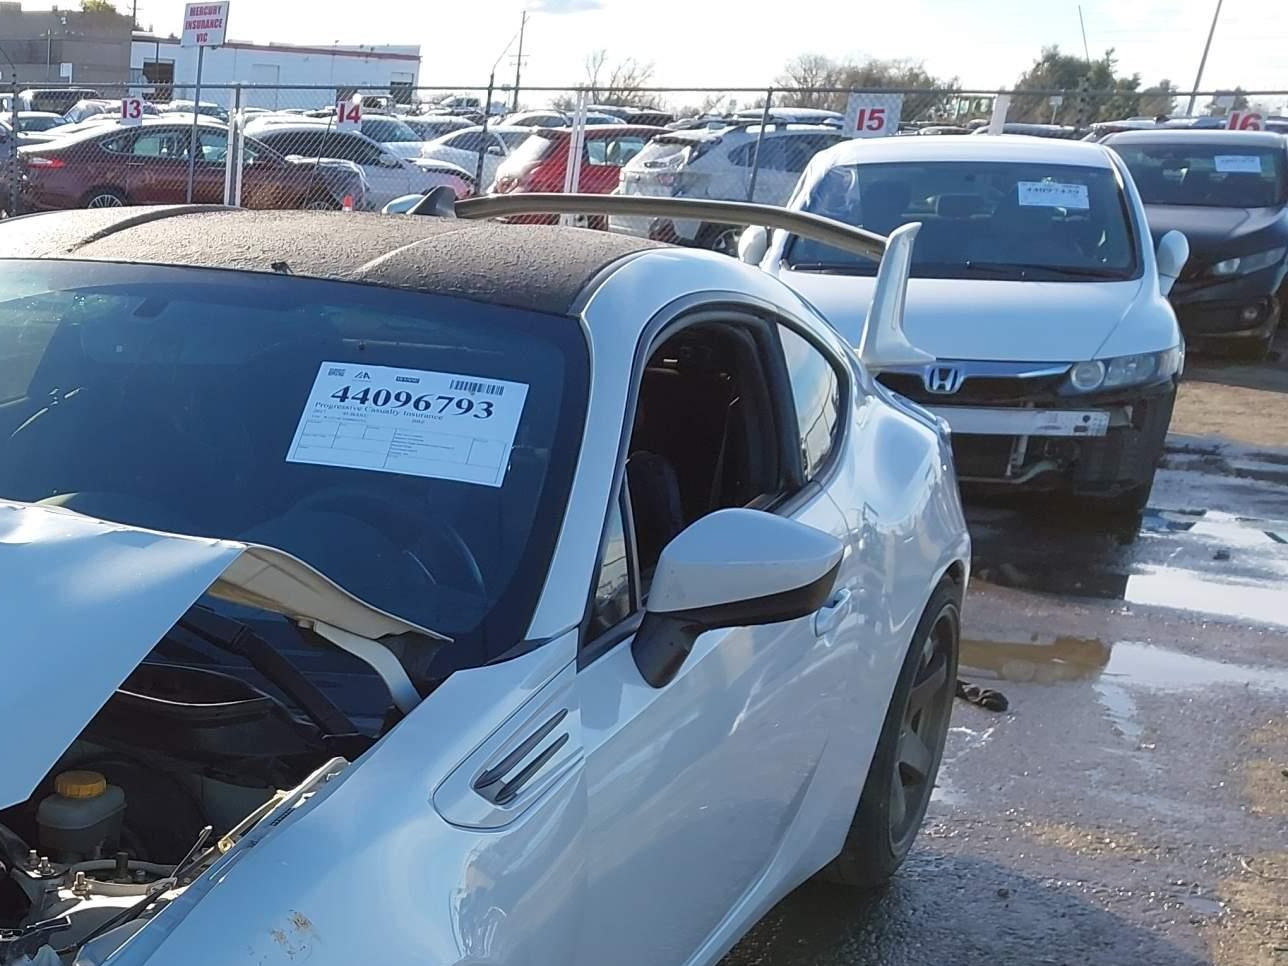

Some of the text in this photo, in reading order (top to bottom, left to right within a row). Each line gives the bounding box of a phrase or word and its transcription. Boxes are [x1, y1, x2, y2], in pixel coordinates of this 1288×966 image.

[189, 5, 222, 17] MERCURY
[185, 18, 223, 30] INSURANCE
[196, 32, 209, 43] VIC
[122, 99, 142, 119] 13
[338, 103, 361, 124] 14
[856, 108, 886, 131] 15
[314, 401, 362, 412] Progressive
[364, 406, 400, 416] Casualty
[403, 410, 444, 421] Insurance
[330, 384, 495, 420] 44096793
